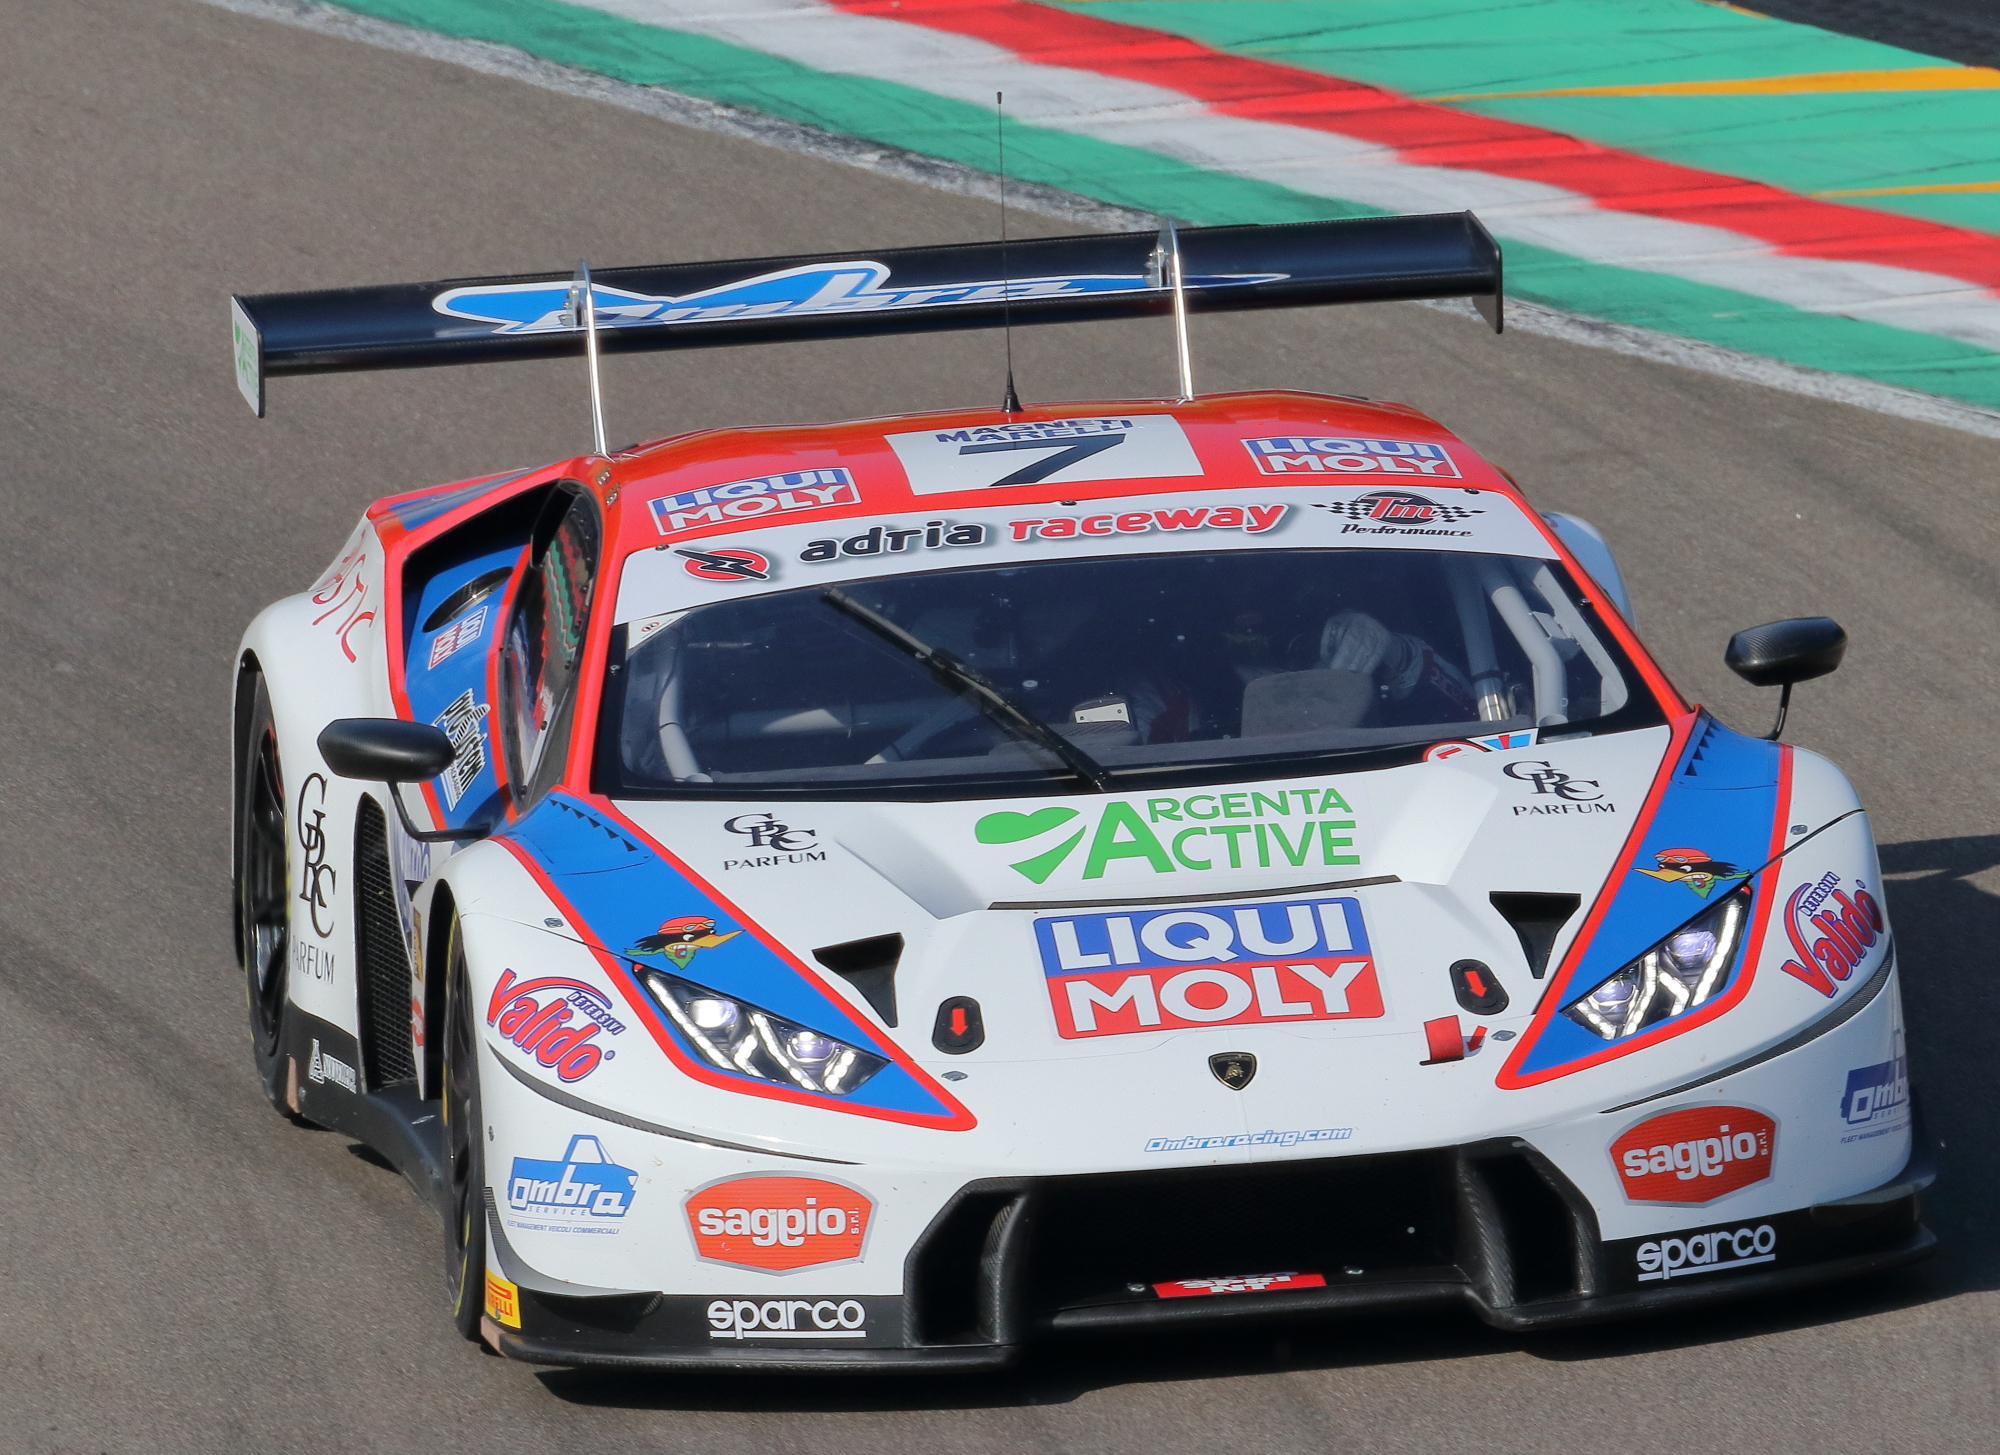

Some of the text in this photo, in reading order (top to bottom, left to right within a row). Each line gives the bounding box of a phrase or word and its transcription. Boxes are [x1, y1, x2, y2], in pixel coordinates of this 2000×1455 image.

[935, 420, 1133, 443] MARELLI
[1257, 438, 1436, 458] LIQUI
[959, 433, 1126, 487] 7
[1266, 454, 1445, 474] MOLY
[661, 470, 840, 513] LIQUI
[668, 484, 846, 530] MOLY
[799, 503, 1288, 563] adria raceway
[1340, 523, 1474, 537] Performance
[1512, 803, 1616, 816] PARFUM
[723, 851, 827, 871] PARFUM
[1798, 871, 1841, 917] DETERSIVI
[1050, 903, 1354, 970] LIQUI
[1781, 882, 1884, 998] Valido
[566, 989, 627, 1036] DETERSIVI
[1064, 961, 1369, 1033] MOLY
[486, 967, 613, 1084] Valido
[1144, 1127, 1353, 1152] Ombraracing.com
[528, 1206, 588, 1217] SERVICE
[573, 1227, 620, 1235] COMMERCIALI
[1636, 1224, 1776, 1282] sparco
[707, 1299, 867, 1340] sparco
